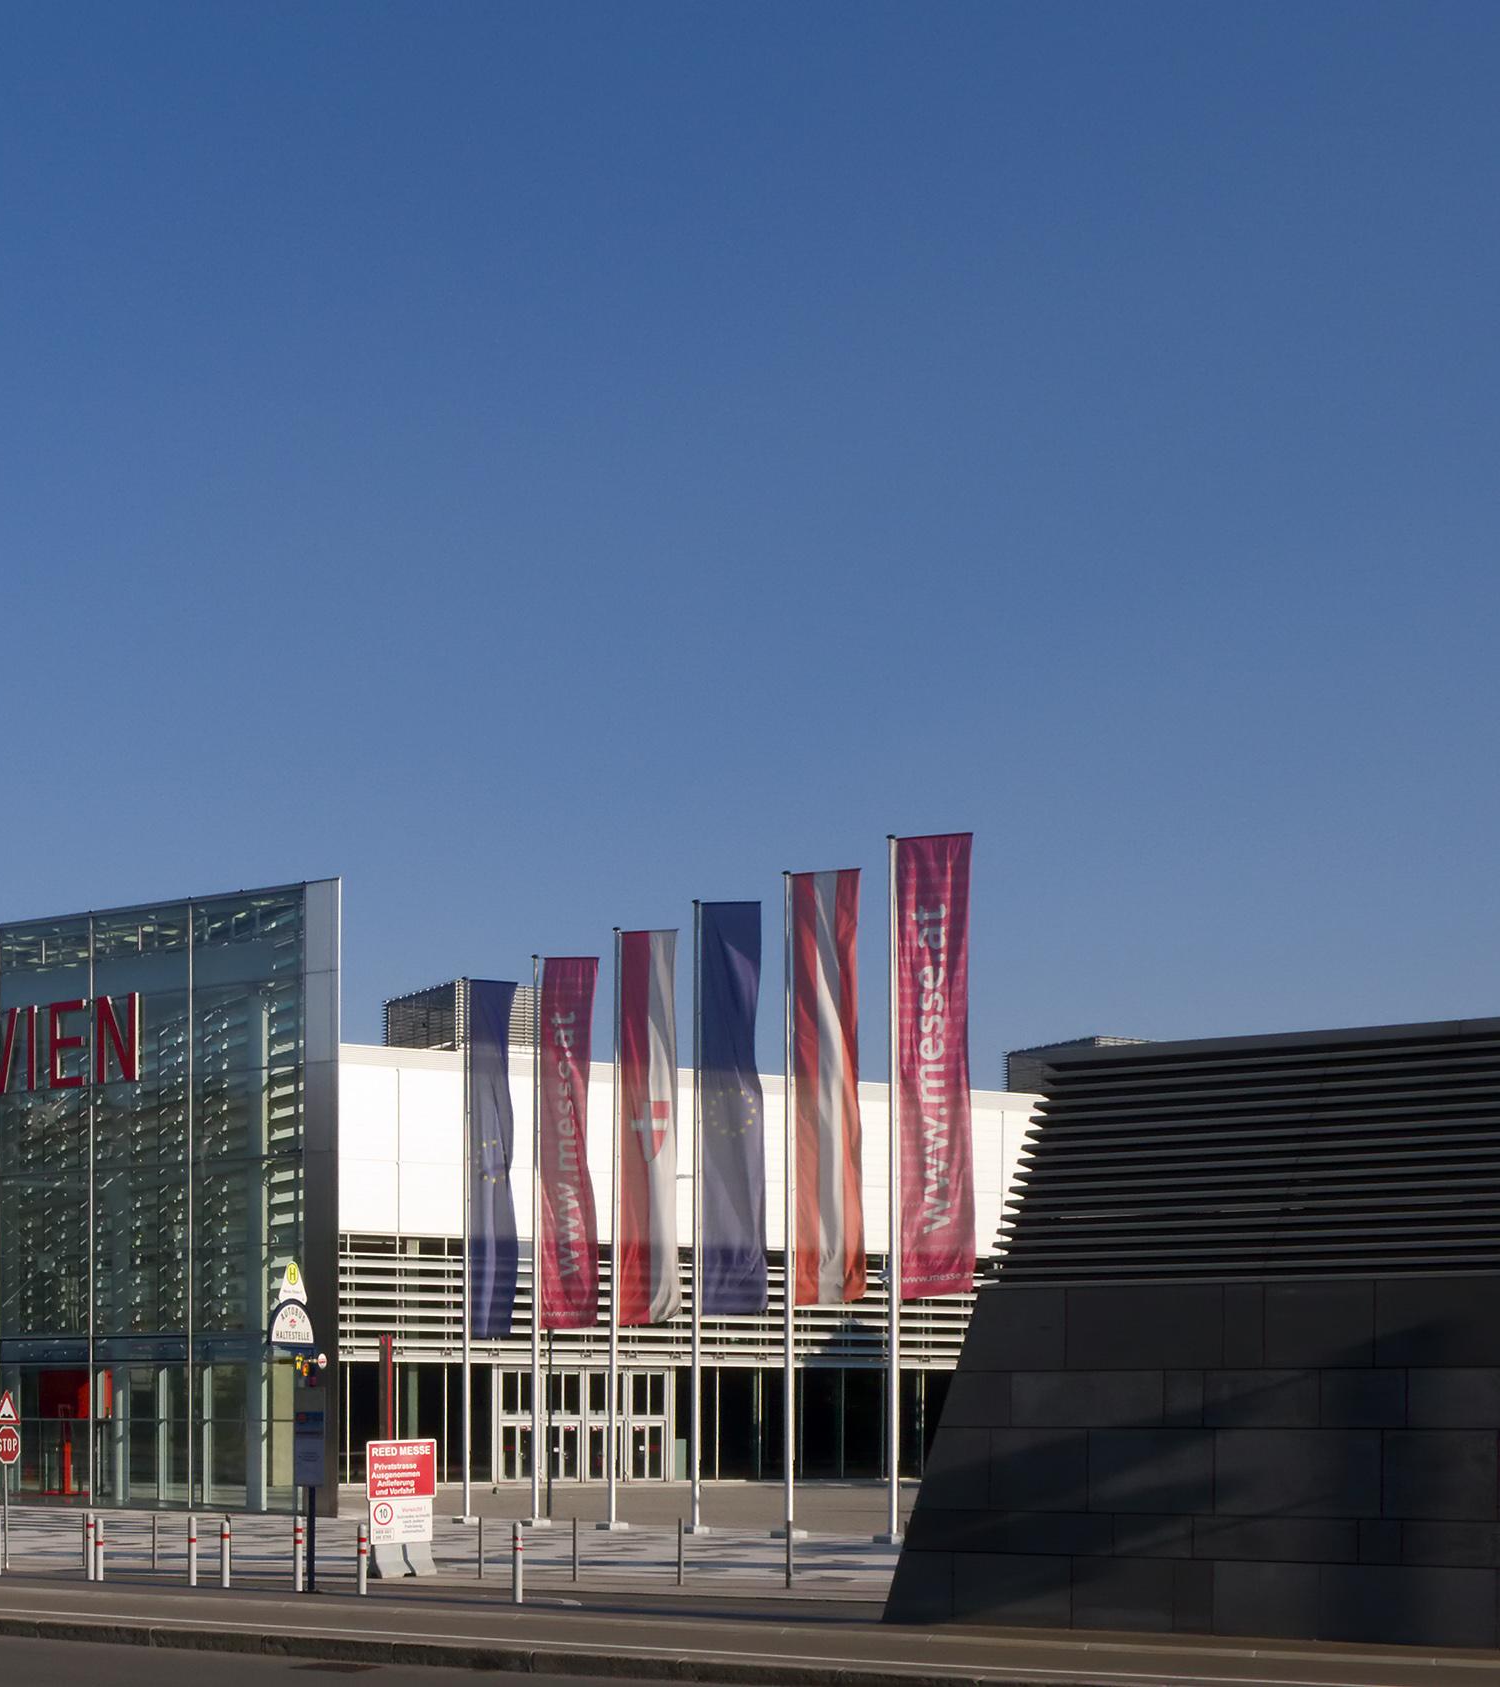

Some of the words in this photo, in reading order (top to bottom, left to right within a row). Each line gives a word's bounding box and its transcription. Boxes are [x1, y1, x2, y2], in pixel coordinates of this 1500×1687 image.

[911, 904, 951, 1233] www.messe.at
[289, 1267, 296, 1281] H
[280, 1306, 306, 1323] AUTOBUS
[276, 1330, 310, 1341] HALTESTELLE
[371, 1446, 397, 1457] REED
[399, 1445, 431, 1456] MESSE
[373, 1463, 417, 1471] Privatstrasse
[371, 1471, 421, 1480] Ausgenommen
[376, 1479, 415, 1488] Anlieferung
[375, 1488, 389, 1496] und
[390, 1487, 416, 1496] Vorfahrt
[379, 1508, 388, 1519] 10
